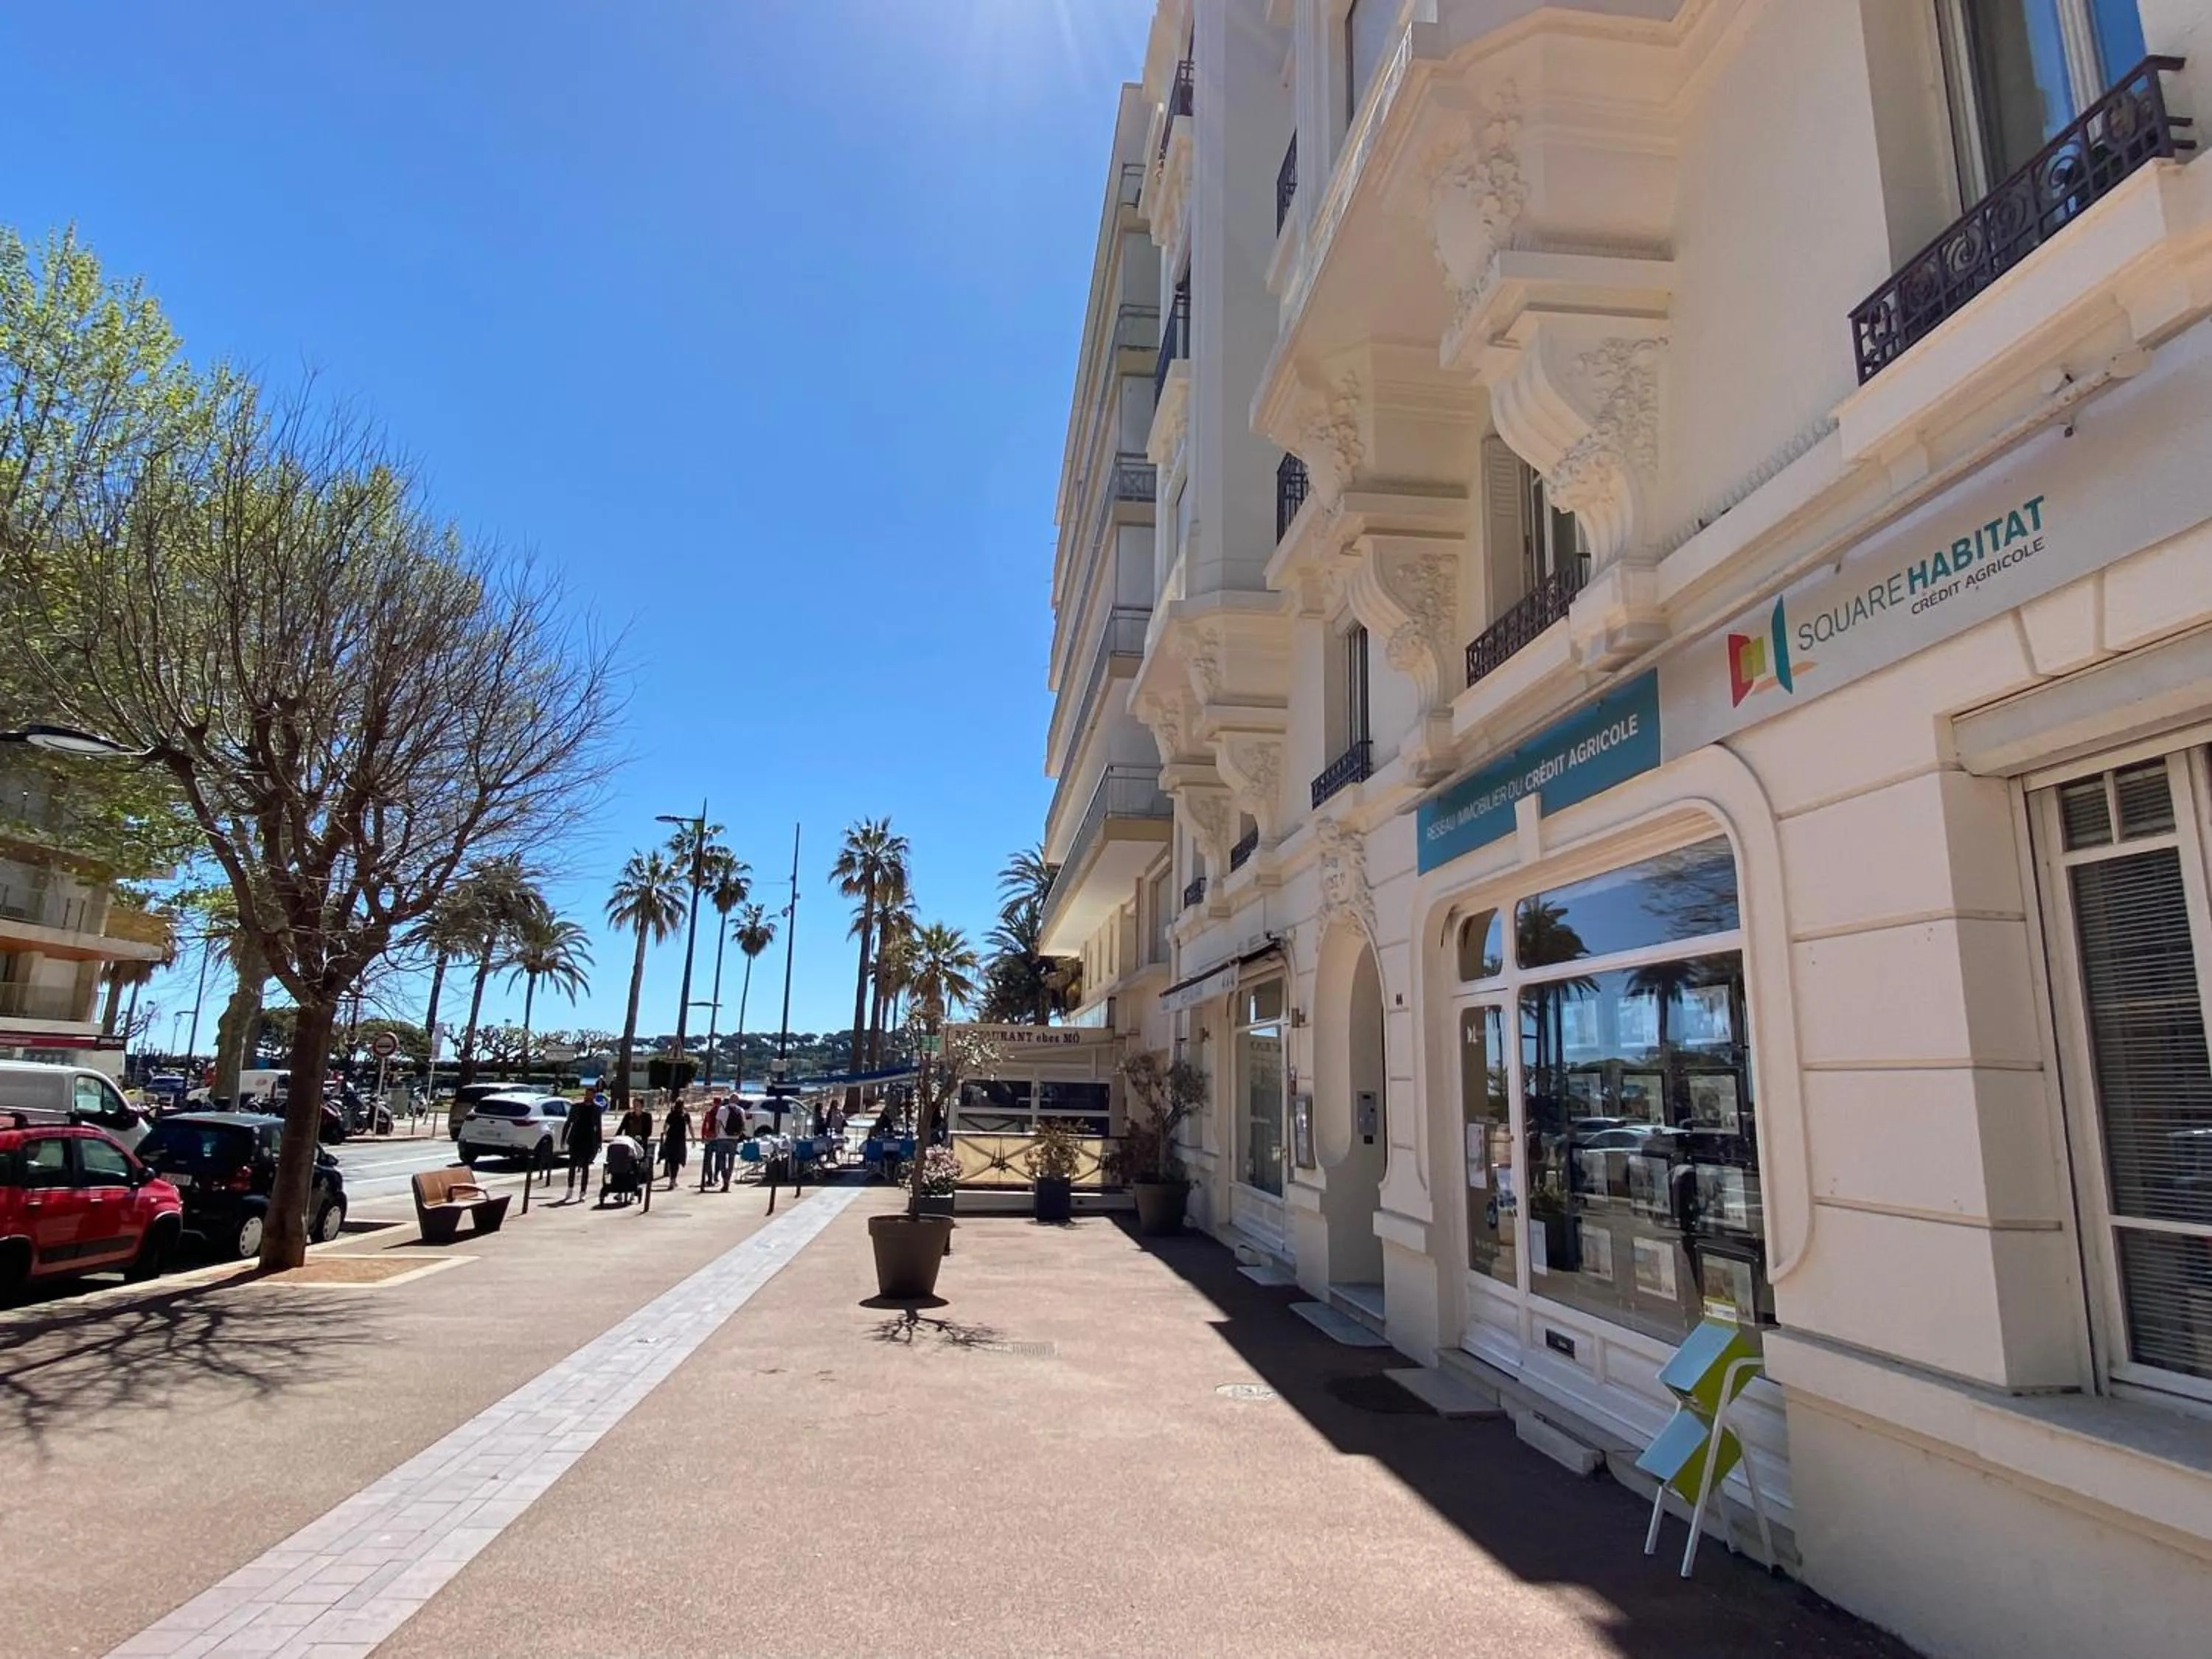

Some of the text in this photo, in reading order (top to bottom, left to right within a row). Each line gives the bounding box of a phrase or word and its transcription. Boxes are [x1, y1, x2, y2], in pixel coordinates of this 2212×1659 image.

[1798, 495, 2045, 651] SQUARE HABITAT
[1965, 536, 2045, 589] AGRICOLE
[1456, 785, 1508, 827] IMMOBILIER
[1508, 778, 1523, 799] DU
[1568, 713, 1639, 769] AGRICOLE
